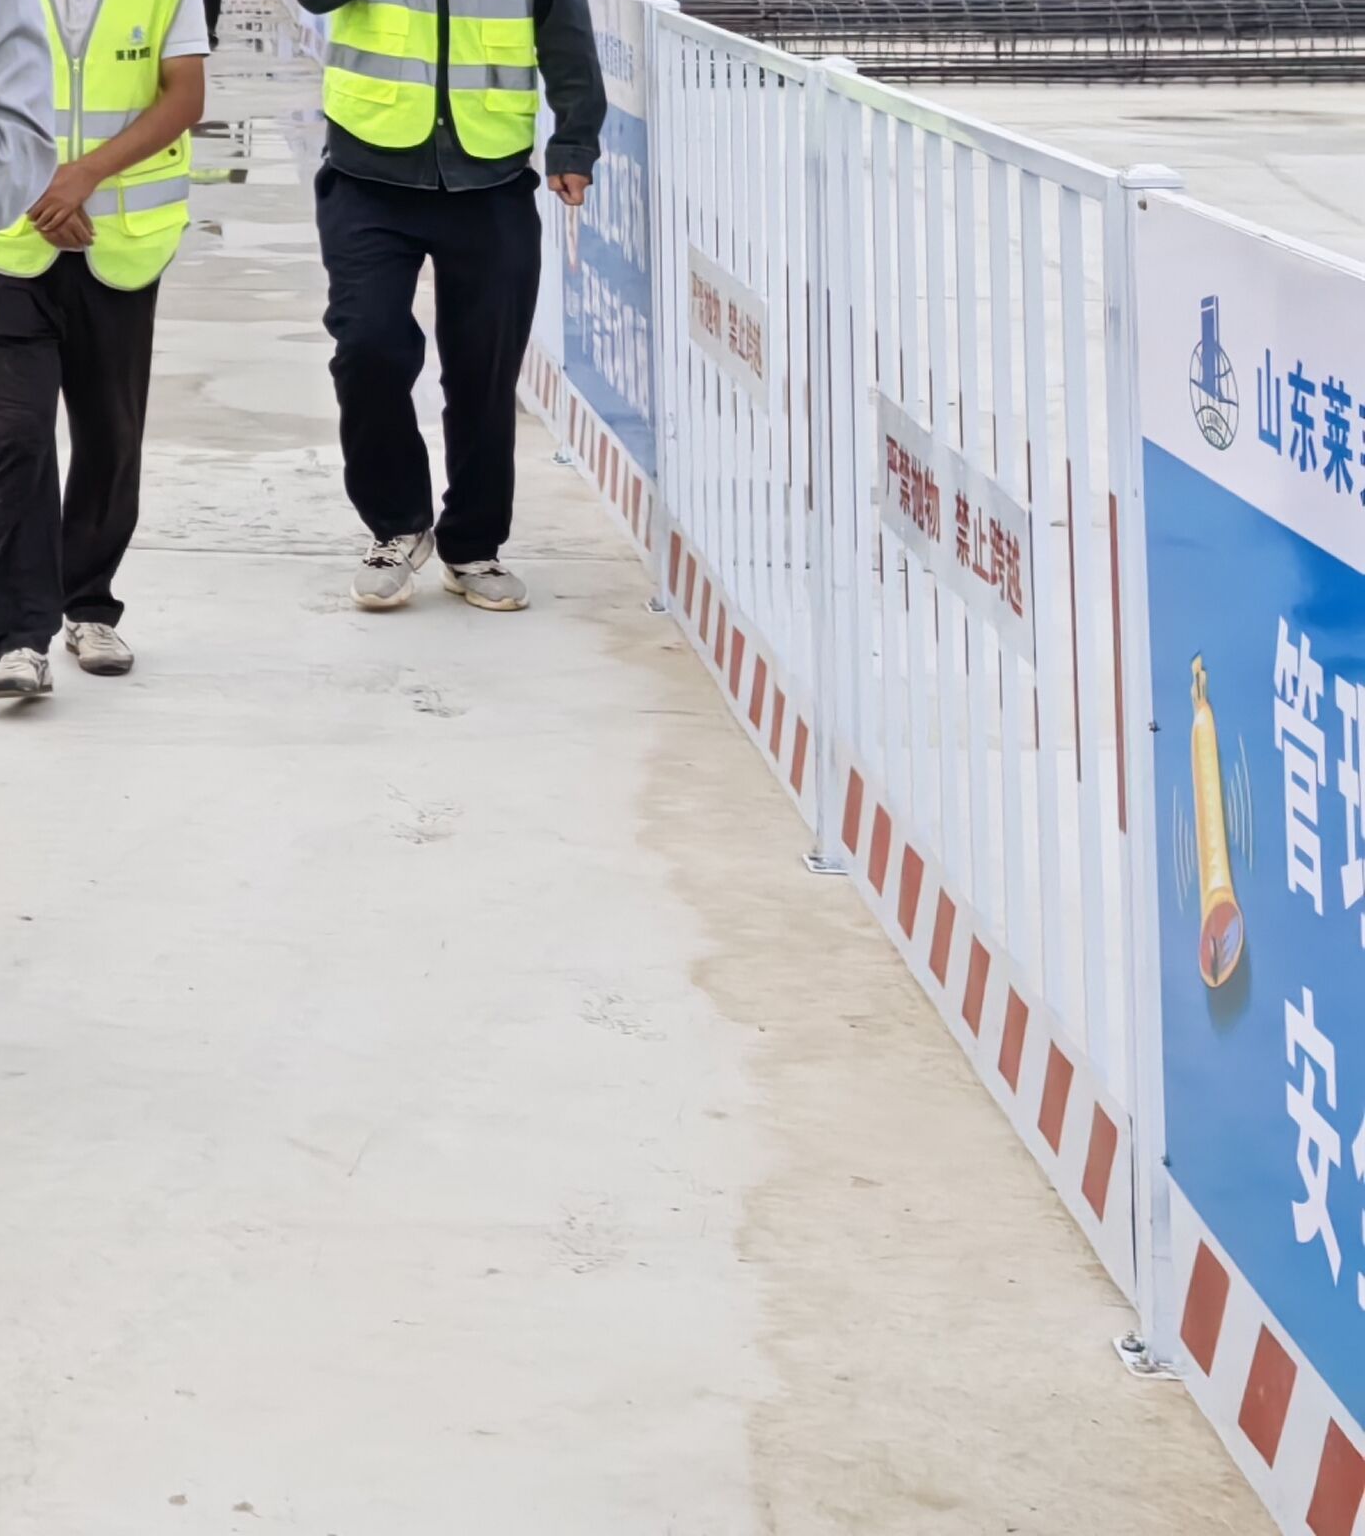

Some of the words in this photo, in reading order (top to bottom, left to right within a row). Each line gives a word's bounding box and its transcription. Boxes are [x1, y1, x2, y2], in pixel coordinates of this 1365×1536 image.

[1257, 348, 1365, 506] 山东莱
[955, 488, 1023, 618] 禁止跨越
[1281, 985, 1365, 1312] 安
